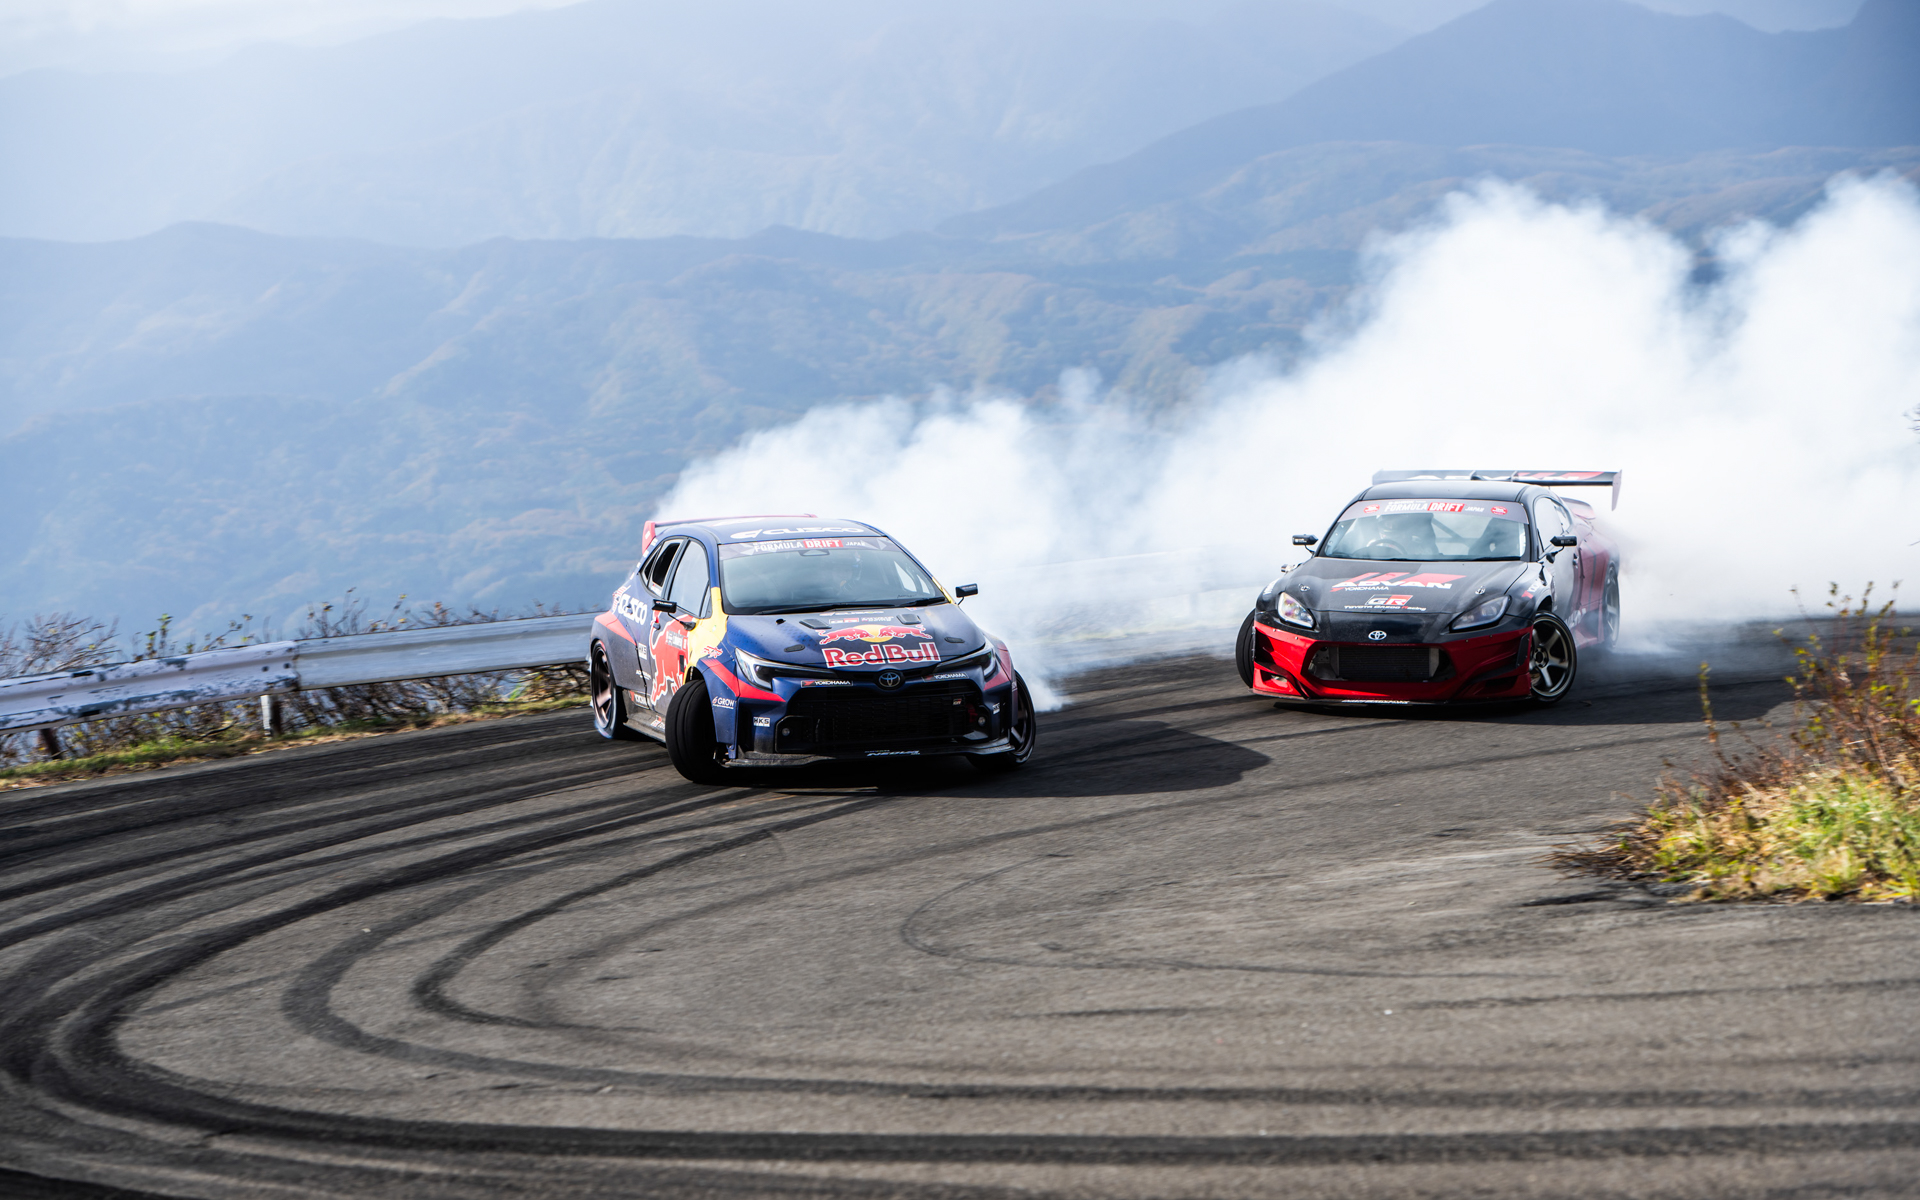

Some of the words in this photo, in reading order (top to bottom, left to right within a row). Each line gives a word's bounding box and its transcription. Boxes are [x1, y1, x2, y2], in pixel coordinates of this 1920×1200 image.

[1384, 503, 1427, 512] FORMULA
[1429, 503, 1462, 512] DRIFT
[763, 527, 865, 535] CUSCO
[754, 541, 803, 552] FORMULA
[805, 540, 841, 549] DRIFT
[1332, 581, 1452, 589] ADVAN
[1366, 596, 1409, 605] GR
[822, 644, 885, 668] Red
[883, 642, 941, 663] Bull
[934, 671, 967, 680] YOKOHAMA
[754, 717, 770, 726] HKS
